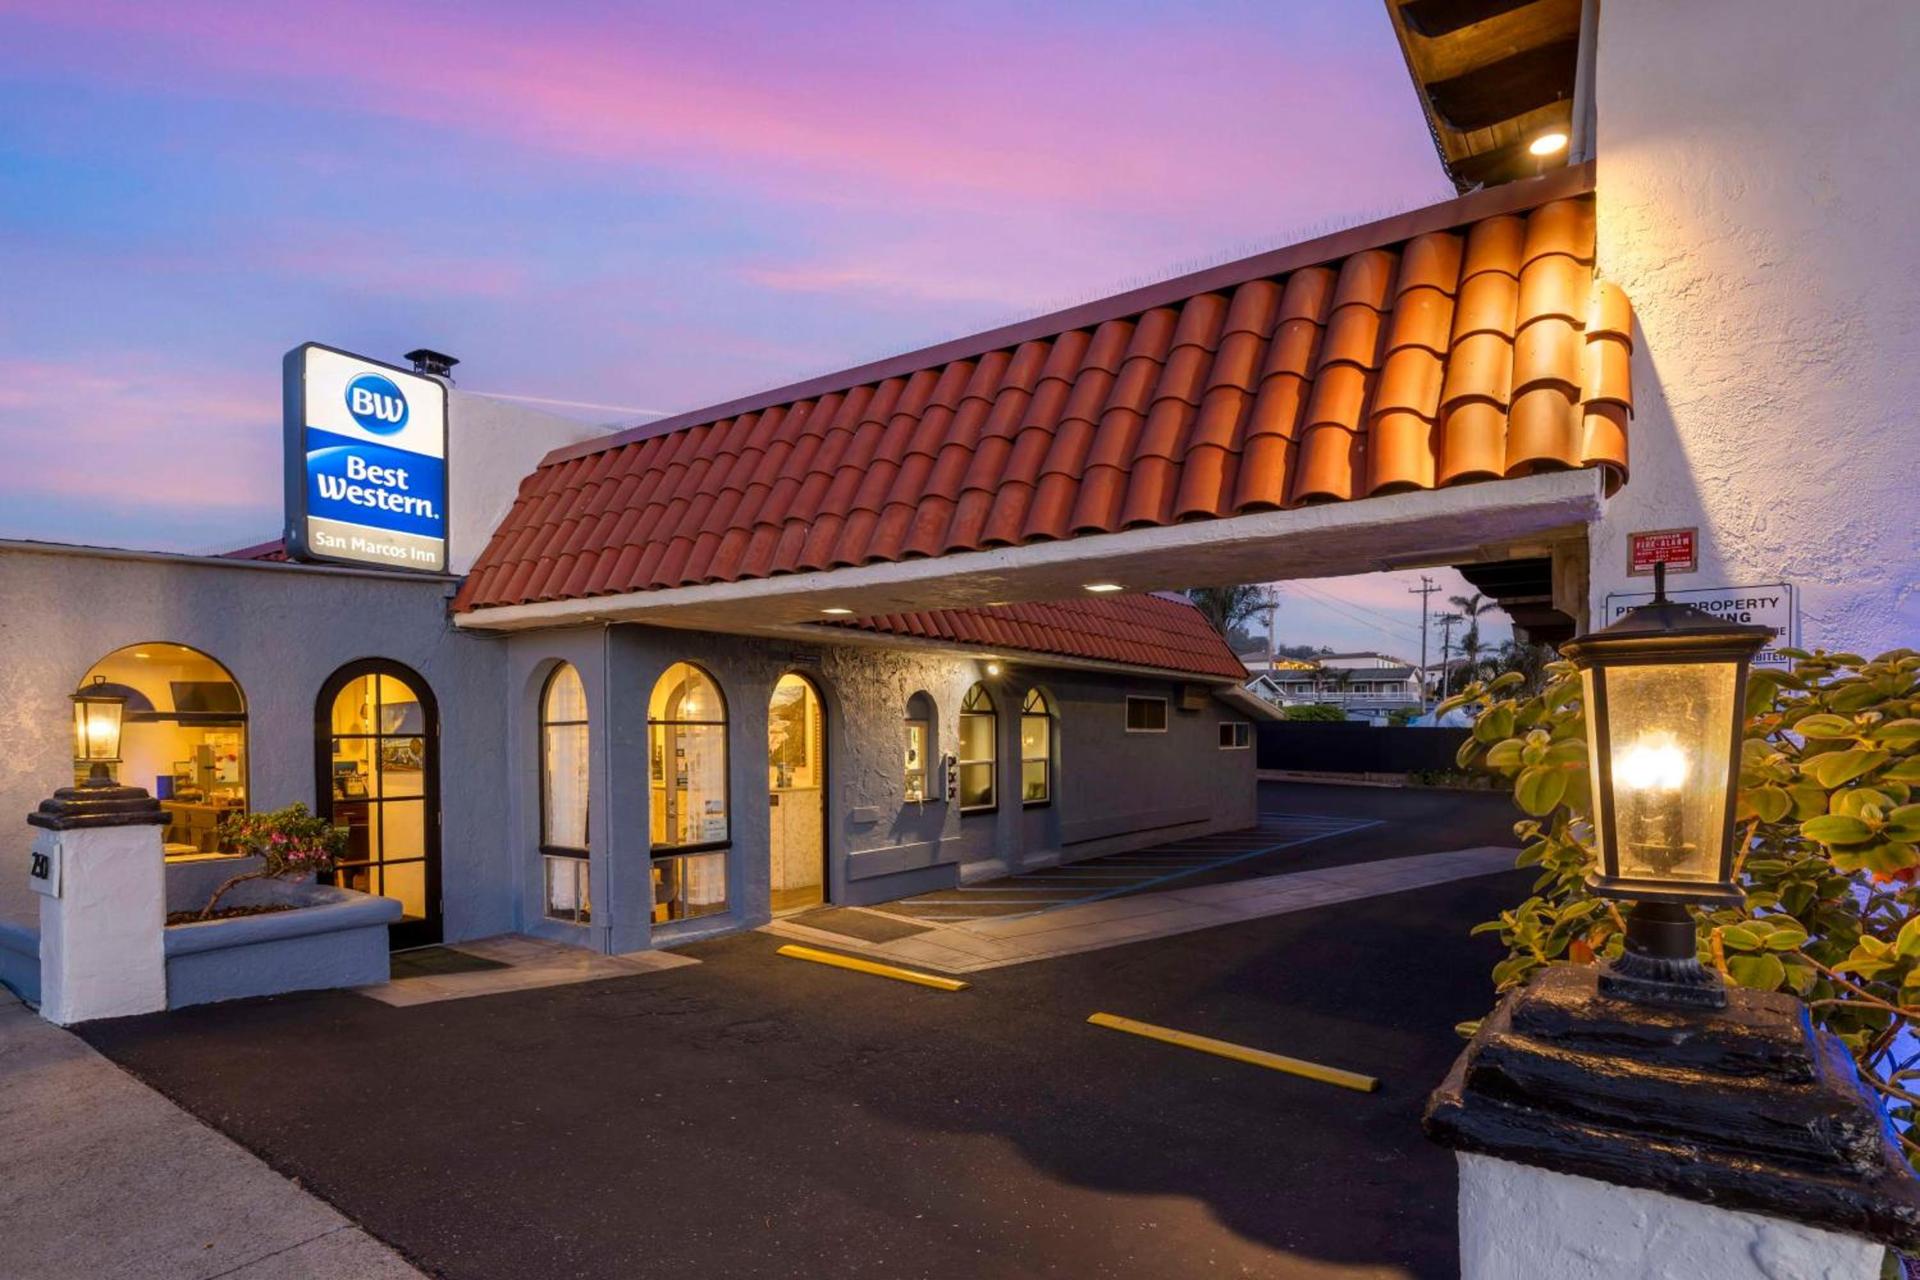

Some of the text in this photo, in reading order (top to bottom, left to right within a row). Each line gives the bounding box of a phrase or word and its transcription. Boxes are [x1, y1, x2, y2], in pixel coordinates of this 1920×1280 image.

[352, 387, 404, 423] BW
[346, 455, 409, 490] Best
[315, 531, 436, 563] San Marcos Inn
